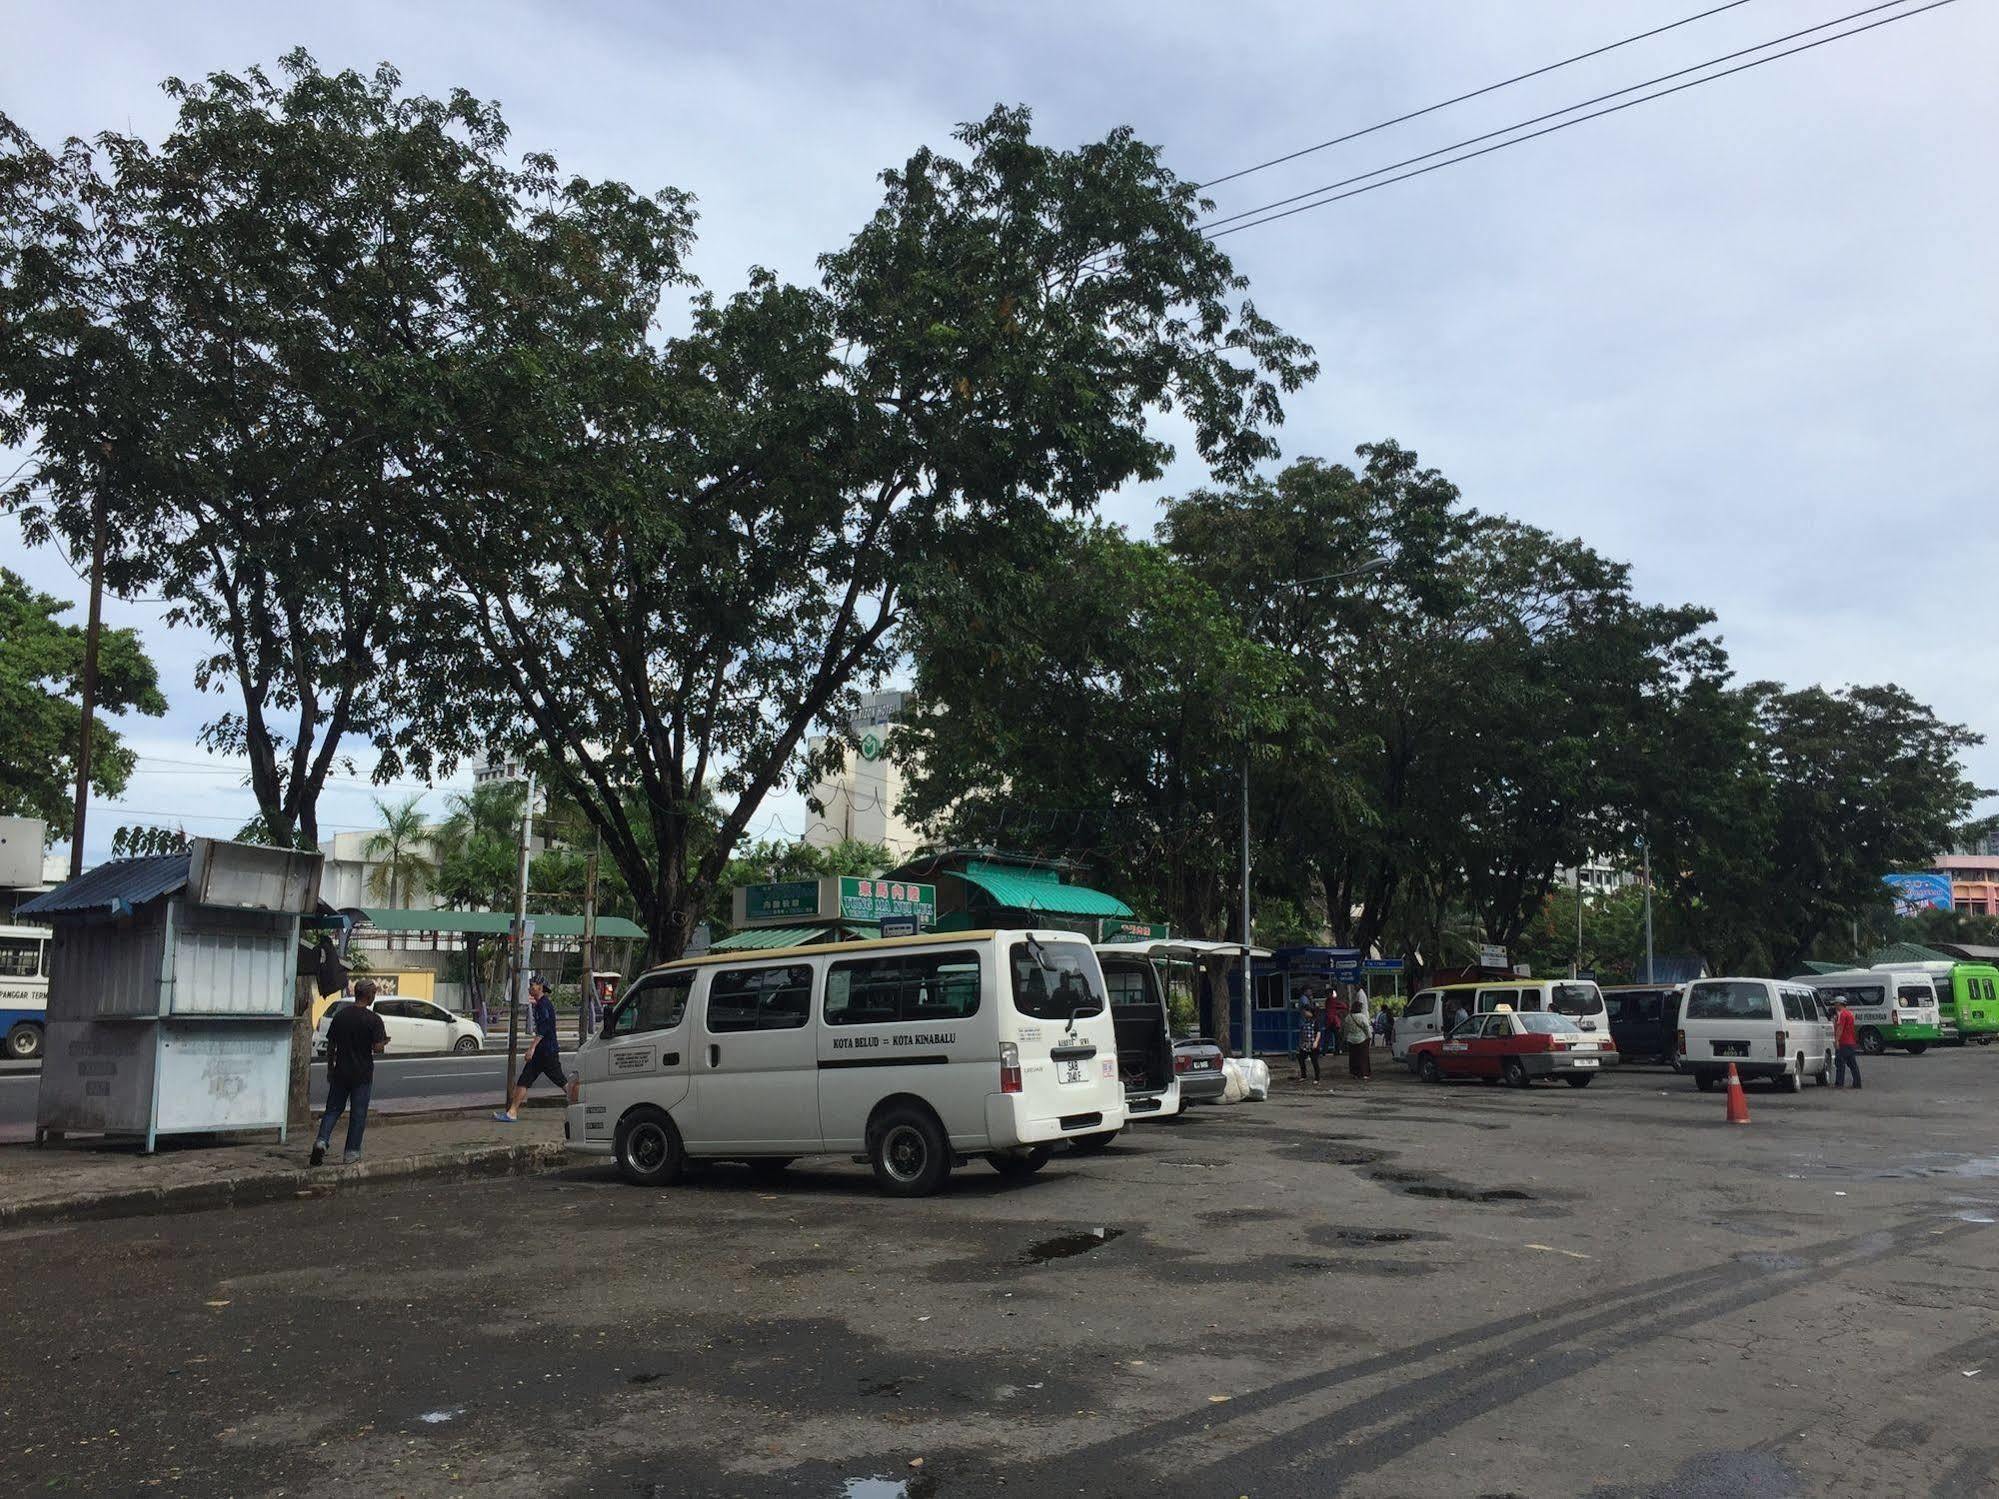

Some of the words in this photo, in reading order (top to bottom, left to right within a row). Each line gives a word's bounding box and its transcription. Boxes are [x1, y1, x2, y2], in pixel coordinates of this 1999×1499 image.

[843, 896, 873, 910] TUNG
[875, 899, 891, 912] MA
[833, 1038, 853, 1049] KOTA
[854, 1037, 879, 1048] BELUD
[892, 1035, 913, 1046] KOTA
[914, 1033, 956, 1045] KINABALU
[1067, 1060, 1079, 1071] SAB
